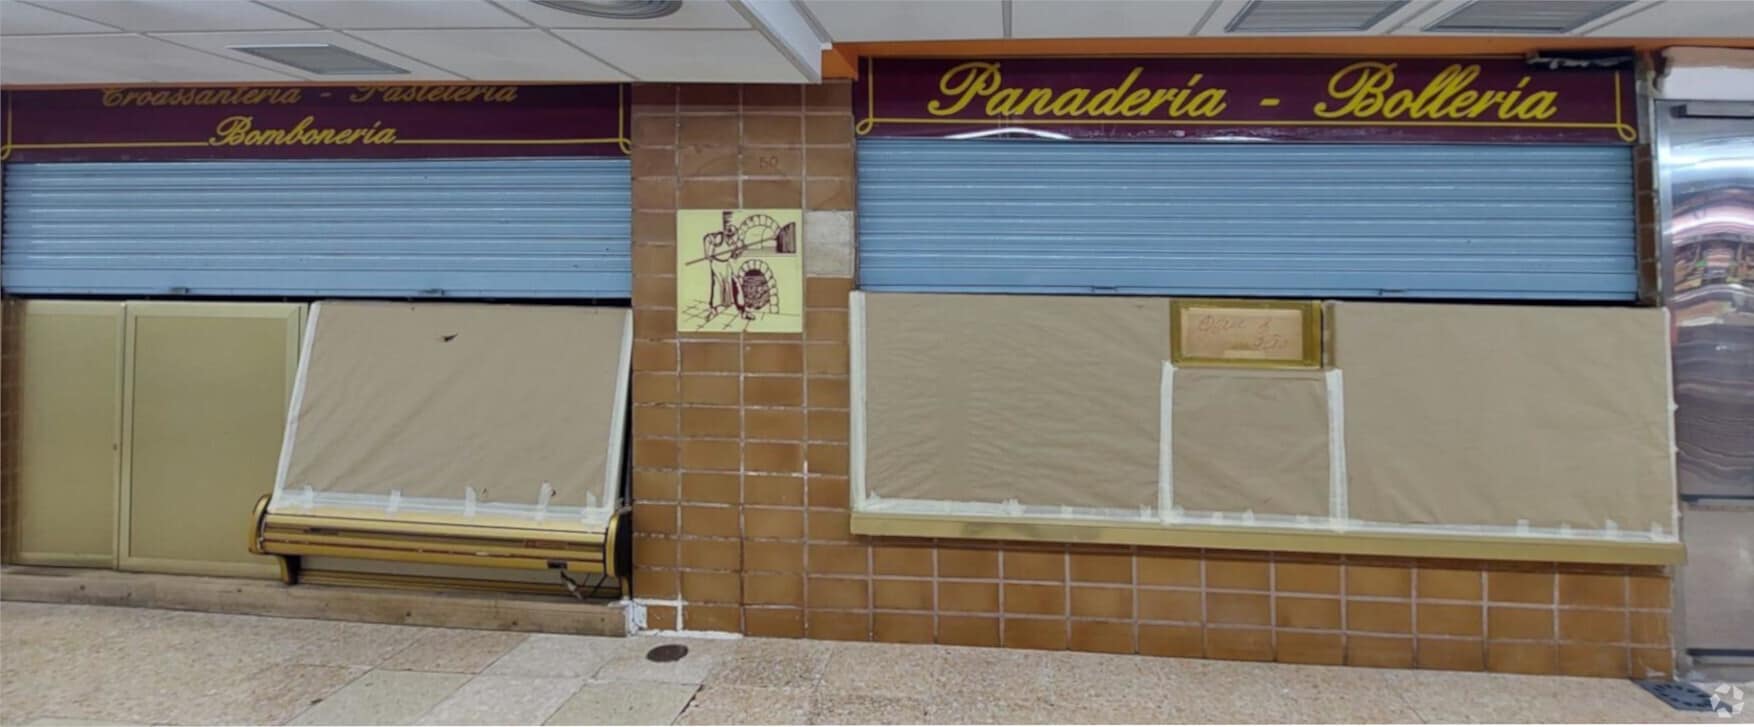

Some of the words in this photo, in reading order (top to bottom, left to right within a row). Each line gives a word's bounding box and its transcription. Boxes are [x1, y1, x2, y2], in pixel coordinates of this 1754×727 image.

[927, 61, 1228, 117] Panadería
[1313, 61, 1558, 119] Bollería
[209, 115, 397, 146] Bombonería
